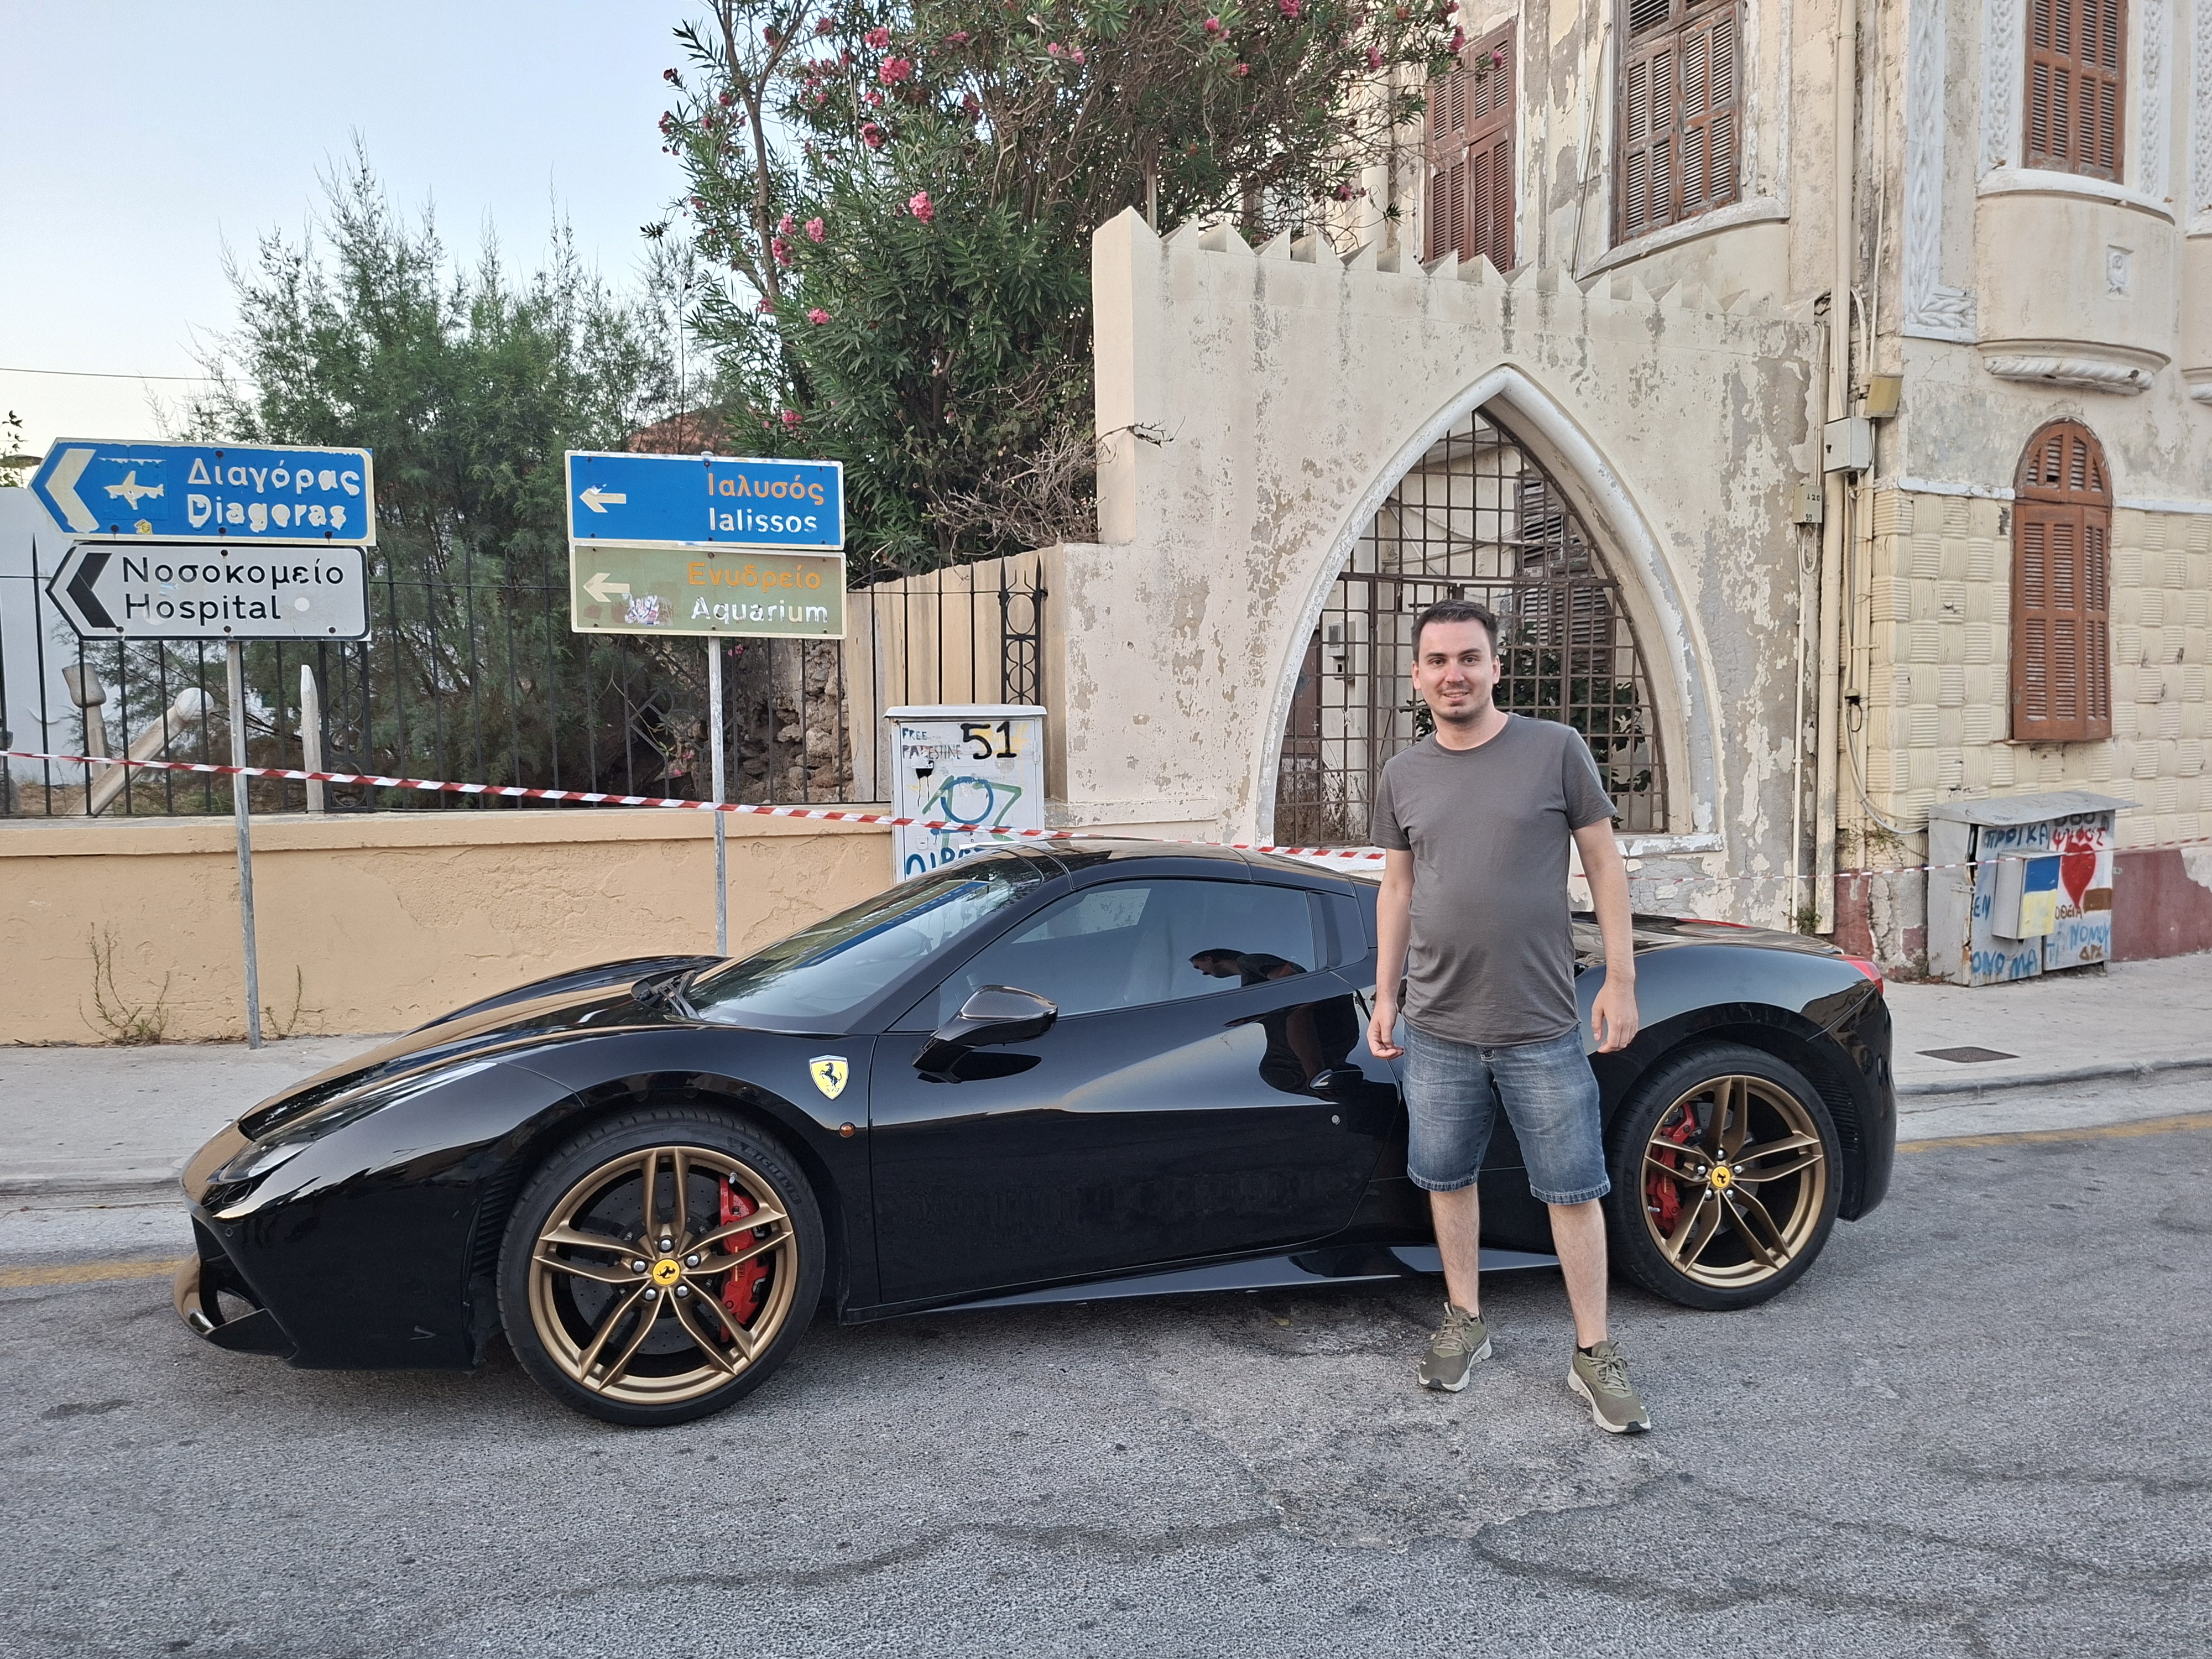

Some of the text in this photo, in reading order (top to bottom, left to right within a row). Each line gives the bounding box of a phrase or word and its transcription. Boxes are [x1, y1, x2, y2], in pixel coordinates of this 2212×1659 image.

[188, 457, 360, 496] Διαγόρας
[708, 473, 825, 505] Ιαλυσός
[187, 494, 347, 533] Diagoras
[709, 507, 817, 533] Ialissos
[123, 556, 344, 589] Νοσοκομείο
[687, 562, 822, 593] Ενυδρείο
[126, 593, 281, 626] Hospital
[691, 597, 828, 625] Aquarium
[902, 727, 927, 740] FREE
[960, 721, 1017, 760] 51
[744, 1146, 802, 1204] MICHELIN
